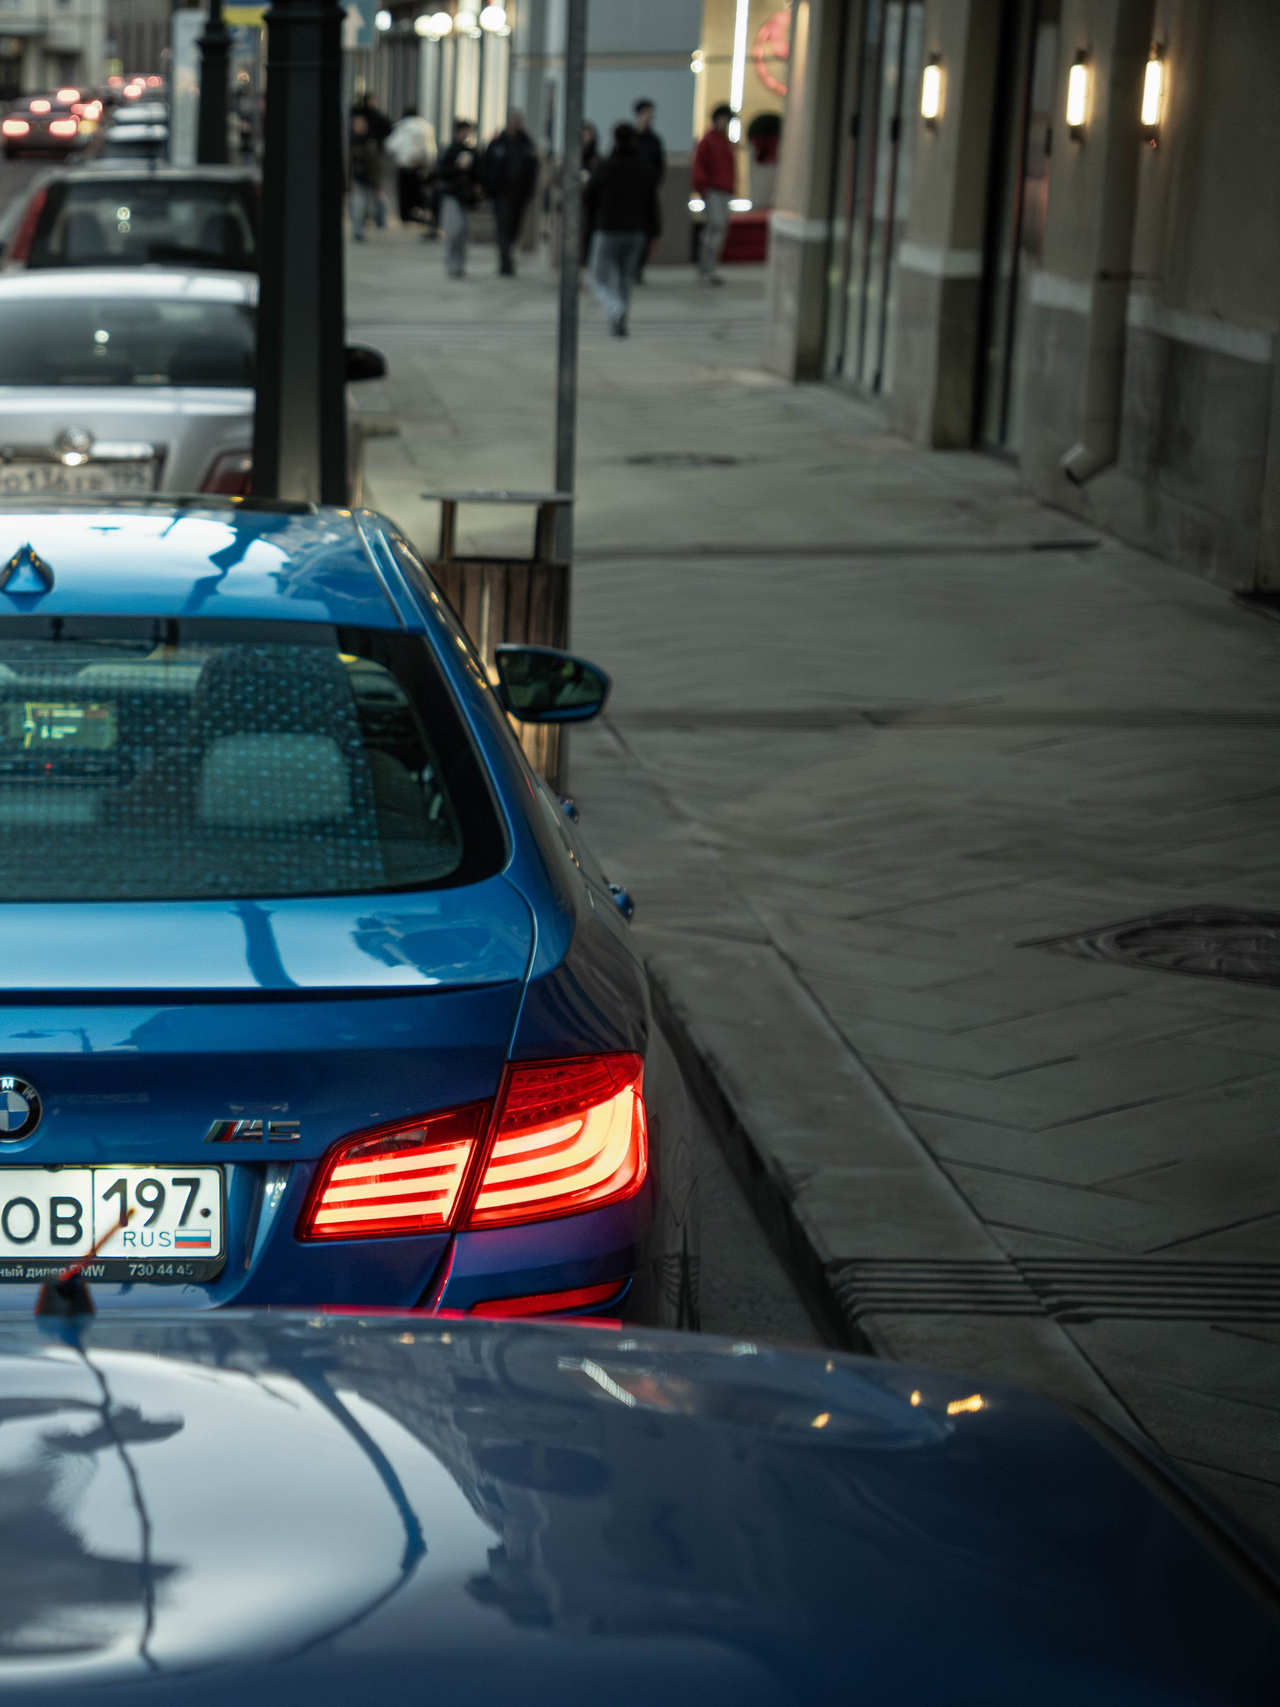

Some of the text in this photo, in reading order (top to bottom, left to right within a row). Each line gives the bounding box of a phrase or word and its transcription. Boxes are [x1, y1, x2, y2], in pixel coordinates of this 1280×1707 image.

[102, 1177, 201, 1228] 197
[123, 1231, 171, 1247] RUS
[129, 1264, 153, 1277] 730
[157, 1264, 174, 1277] 44
